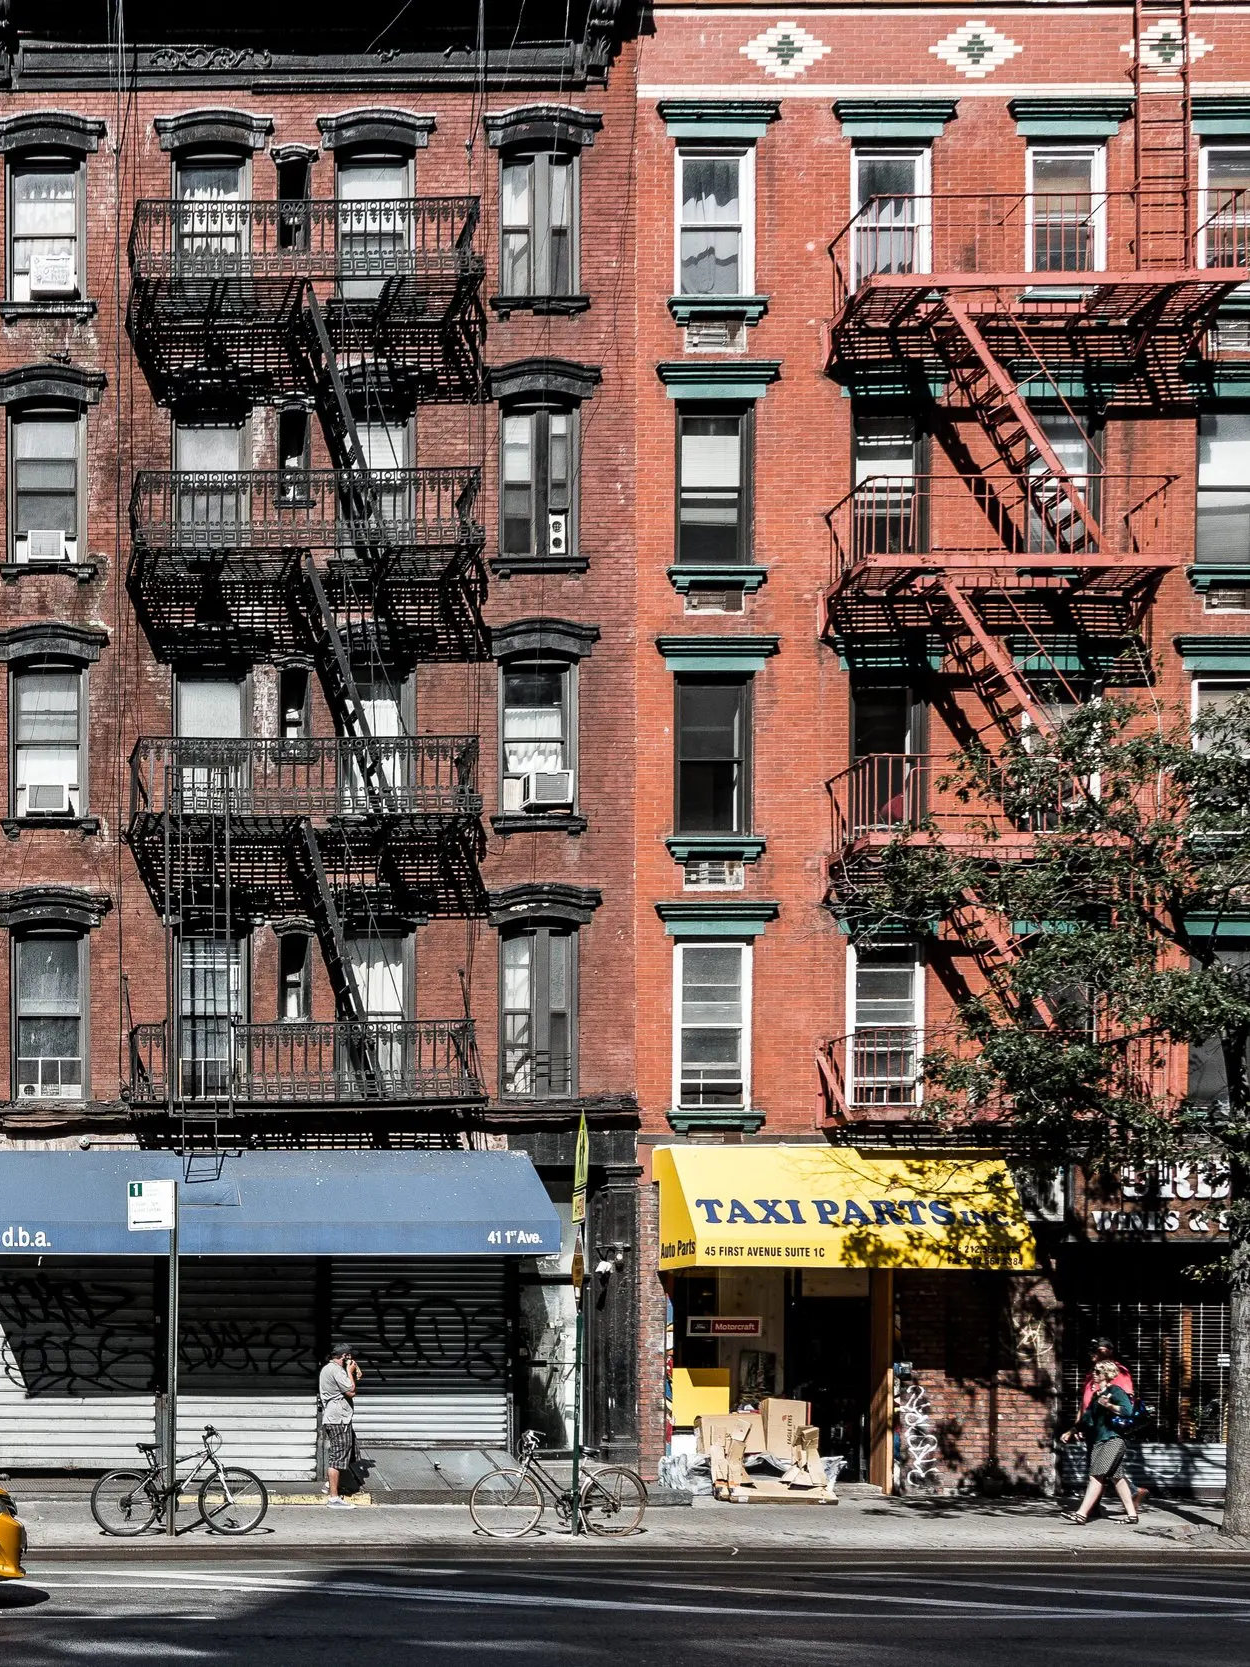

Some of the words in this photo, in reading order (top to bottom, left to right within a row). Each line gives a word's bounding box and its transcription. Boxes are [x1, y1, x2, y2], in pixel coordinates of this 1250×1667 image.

[695, 1199, 807, 1224] TAXI
[811, 1199, 957, 1226] PARTS
[959, 1210, 1017, 1226] INC.
[1, 1226, 51, 1247] d.b.a.
[487, 1230, 501, 1244] 41
[517, 1230, 543, 1244] Ave.
[661, 1242, 676, 1259] Auto
[677, 1239, 696, 1256] Parts
[705, 1246, 716, 1257] 45
[719, 1246, 744, 1257] FIRST
[747, 1246, 782, 1257] AVENUE
[784, 1247, 811, 1257] SUITE
[814, 1247, 825, 1257] 1C
[714, 1323, 756, 1331] Motorcraft
